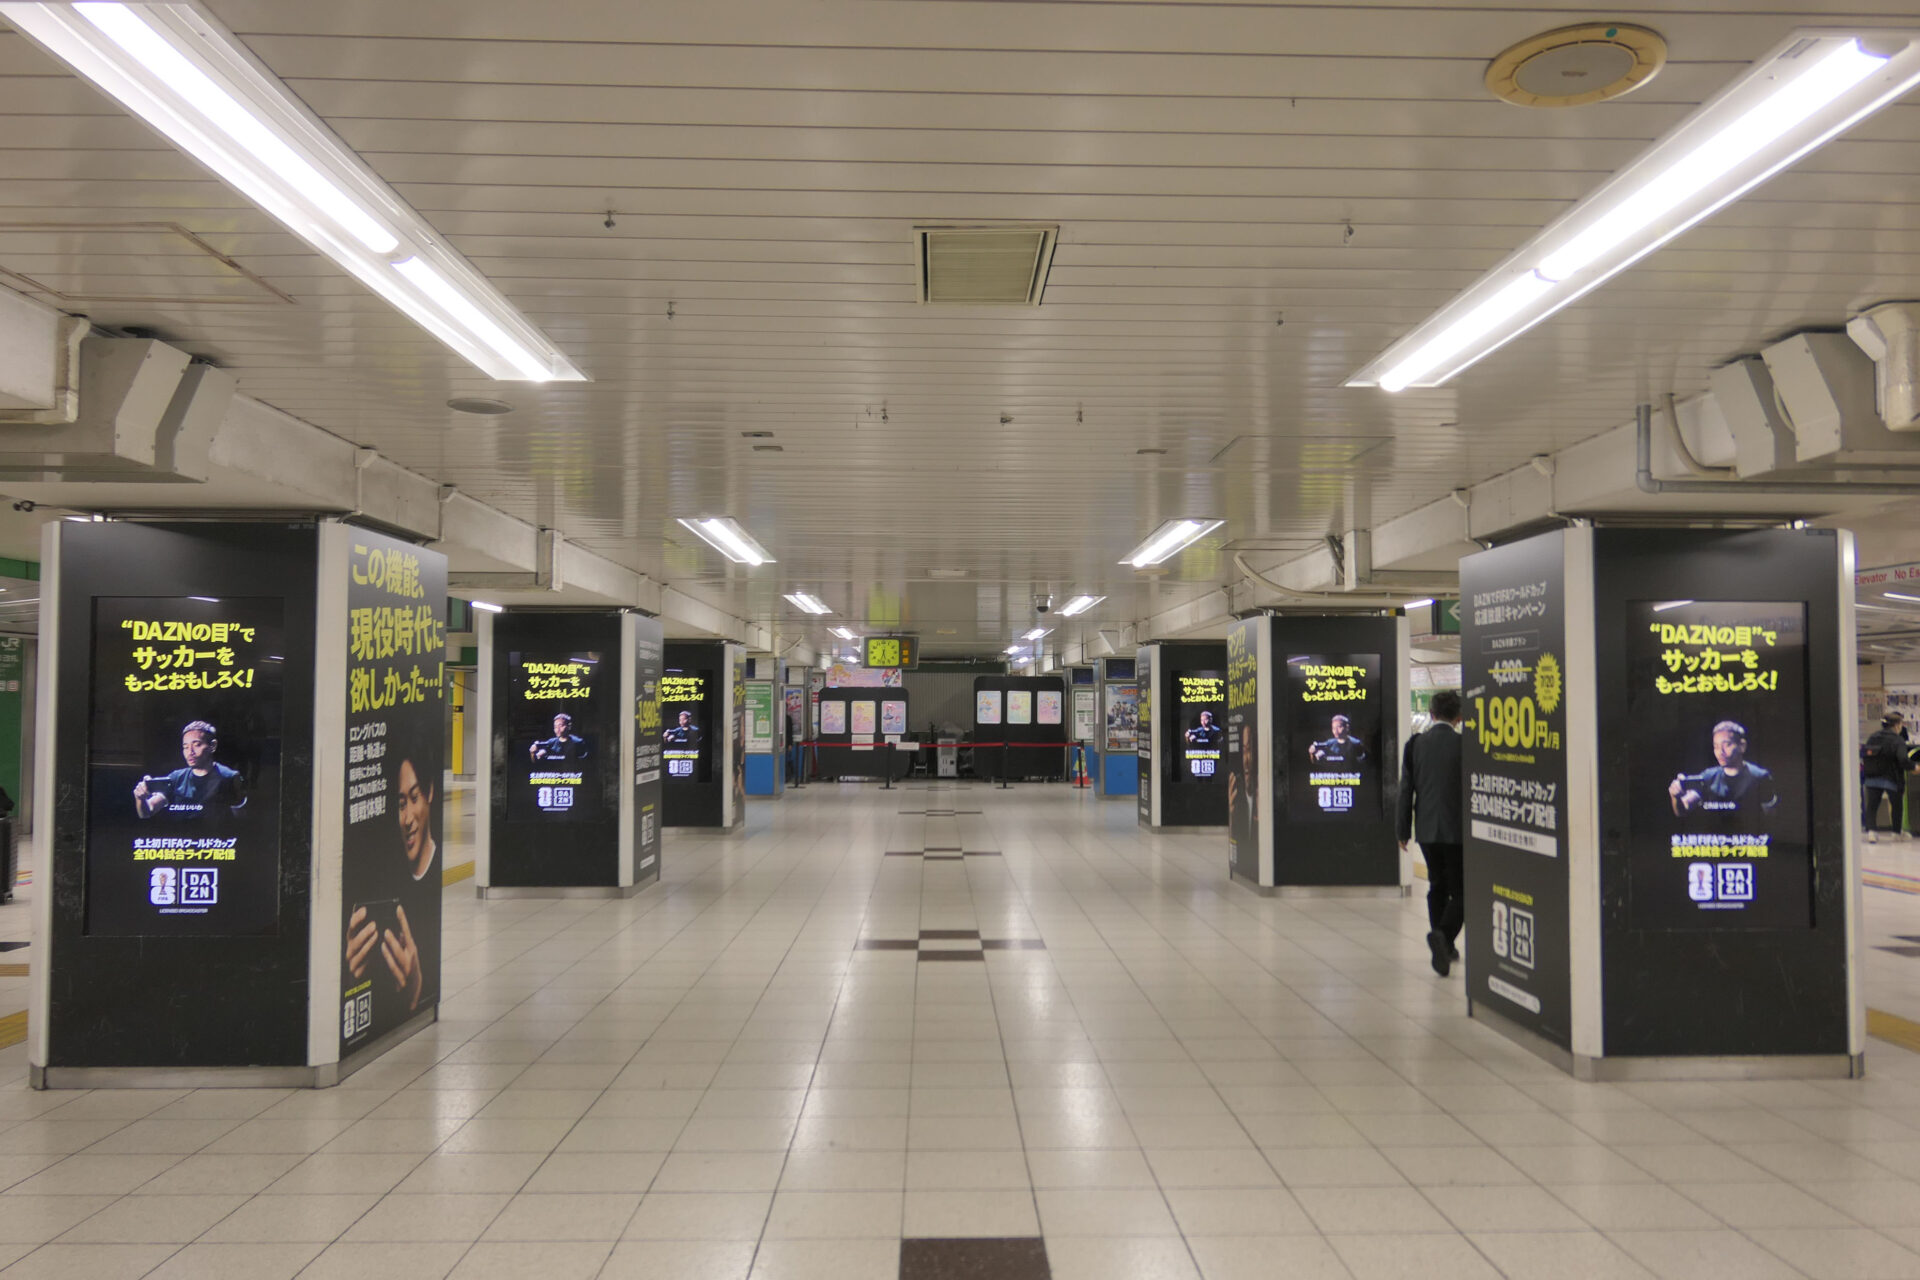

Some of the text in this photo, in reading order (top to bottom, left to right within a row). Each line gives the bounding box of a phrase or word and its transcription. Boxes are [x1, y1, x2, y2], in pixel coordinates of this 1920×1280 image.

[352, 544, 425, 599] この機能、
[1894, 569, 1906, 580] No
[121, 620, 255, 643] “DAZNの目”で
[350, 604, 444, 661] 現役時代に
[1649, 623, 1778, 647] “DAZNの目”で
[132, 645, 235, 670] サッカーを
[1661, 646, 1759, 673] サッカーを
[125, 668, 254, 692] もっとおもしろく!
[528, 675, 580, 689] サッカーを
[1306, 677, 1357, 691] サッカーを
[1655, 669, 1778, 695] もっとおもしろく!
[350, 722, 387, 742] ロングパスの
[1471, 792, 1556, 830] 全104試合ライブ配信
[133, 848, 236, 860] 全104試合ライブ配信
